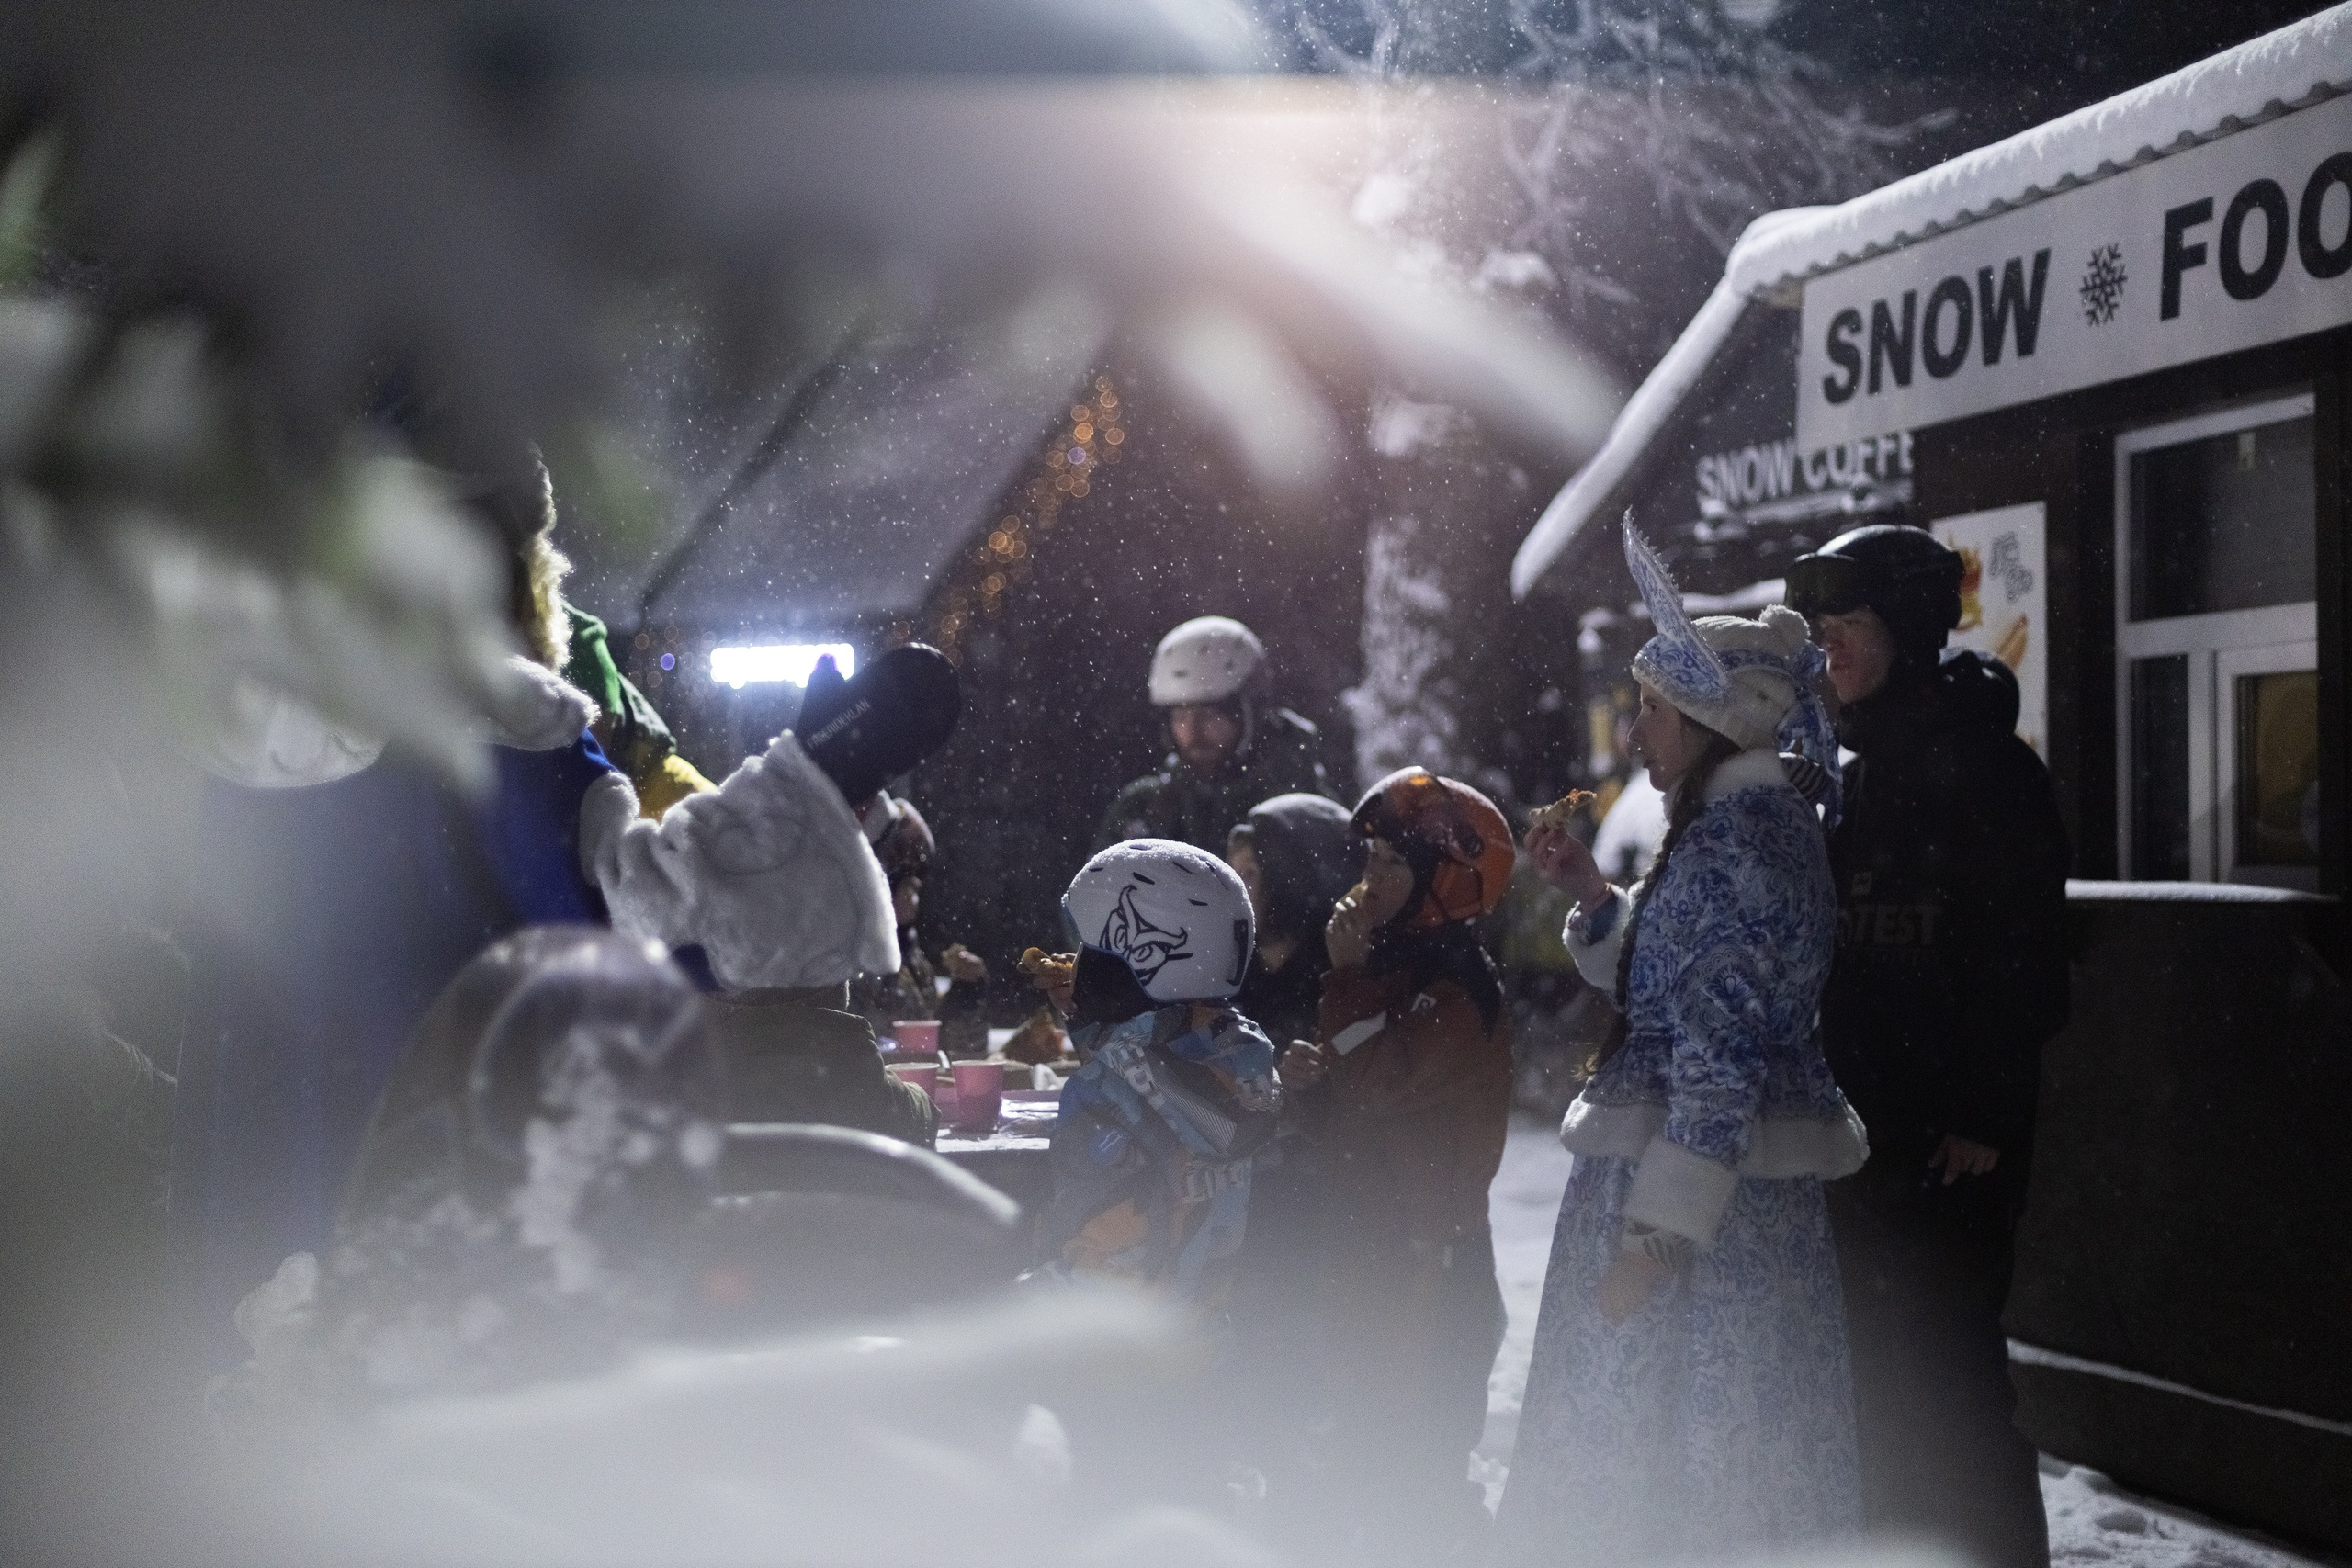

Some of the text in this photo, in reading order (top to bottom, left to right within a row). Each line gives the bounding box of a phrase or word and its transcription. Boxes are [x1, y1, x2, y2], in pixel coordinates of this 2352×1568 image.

[1823, 151, 2352, 405] SNOW FOO
[1698, 439, 1794, 504] SNOW
